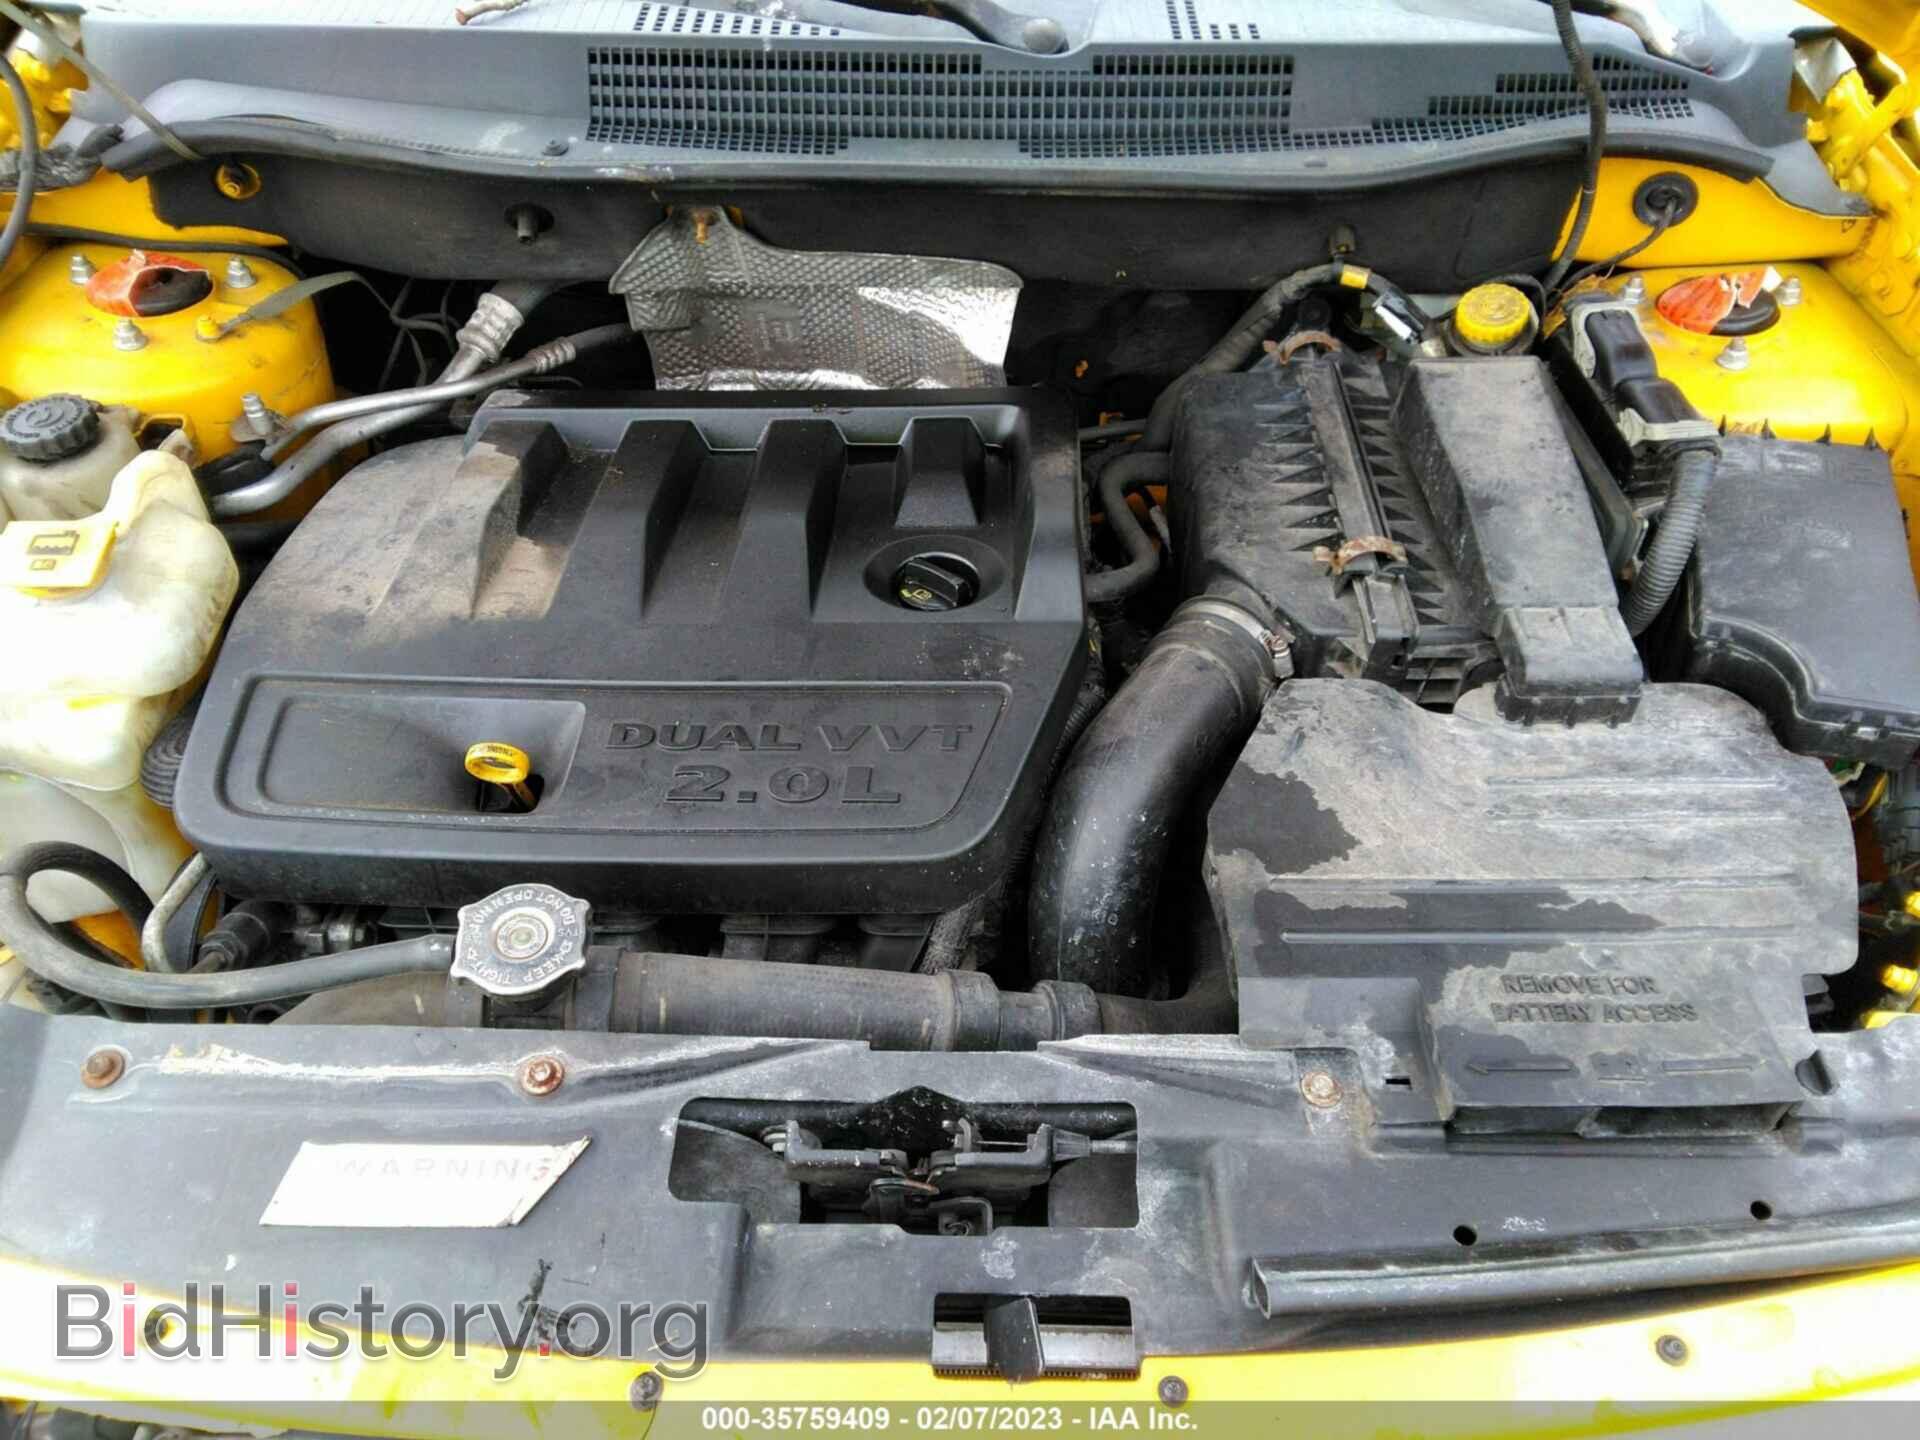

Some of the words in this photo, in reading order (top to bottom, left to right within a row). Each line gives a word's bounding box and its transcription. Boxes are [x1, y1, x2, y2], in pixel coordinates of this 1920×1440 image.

[605, 721, 801, 752] DUAL
[816, 722, 974, 753] VVT
[665, 764, 902, 804] 2.0L
[492, 889, 534, 907] OPEN
[536, 893, 565, 911] NOT
[523, 952, 565, 982] KEEP
[1500, 975, 1601, 995] REMOVE
[1607, 975, 1660, 995] FOR
[1490, 1002, 1591, 1023] BATTERY
[1601, 1003, 1698, 1023] ACCESS
